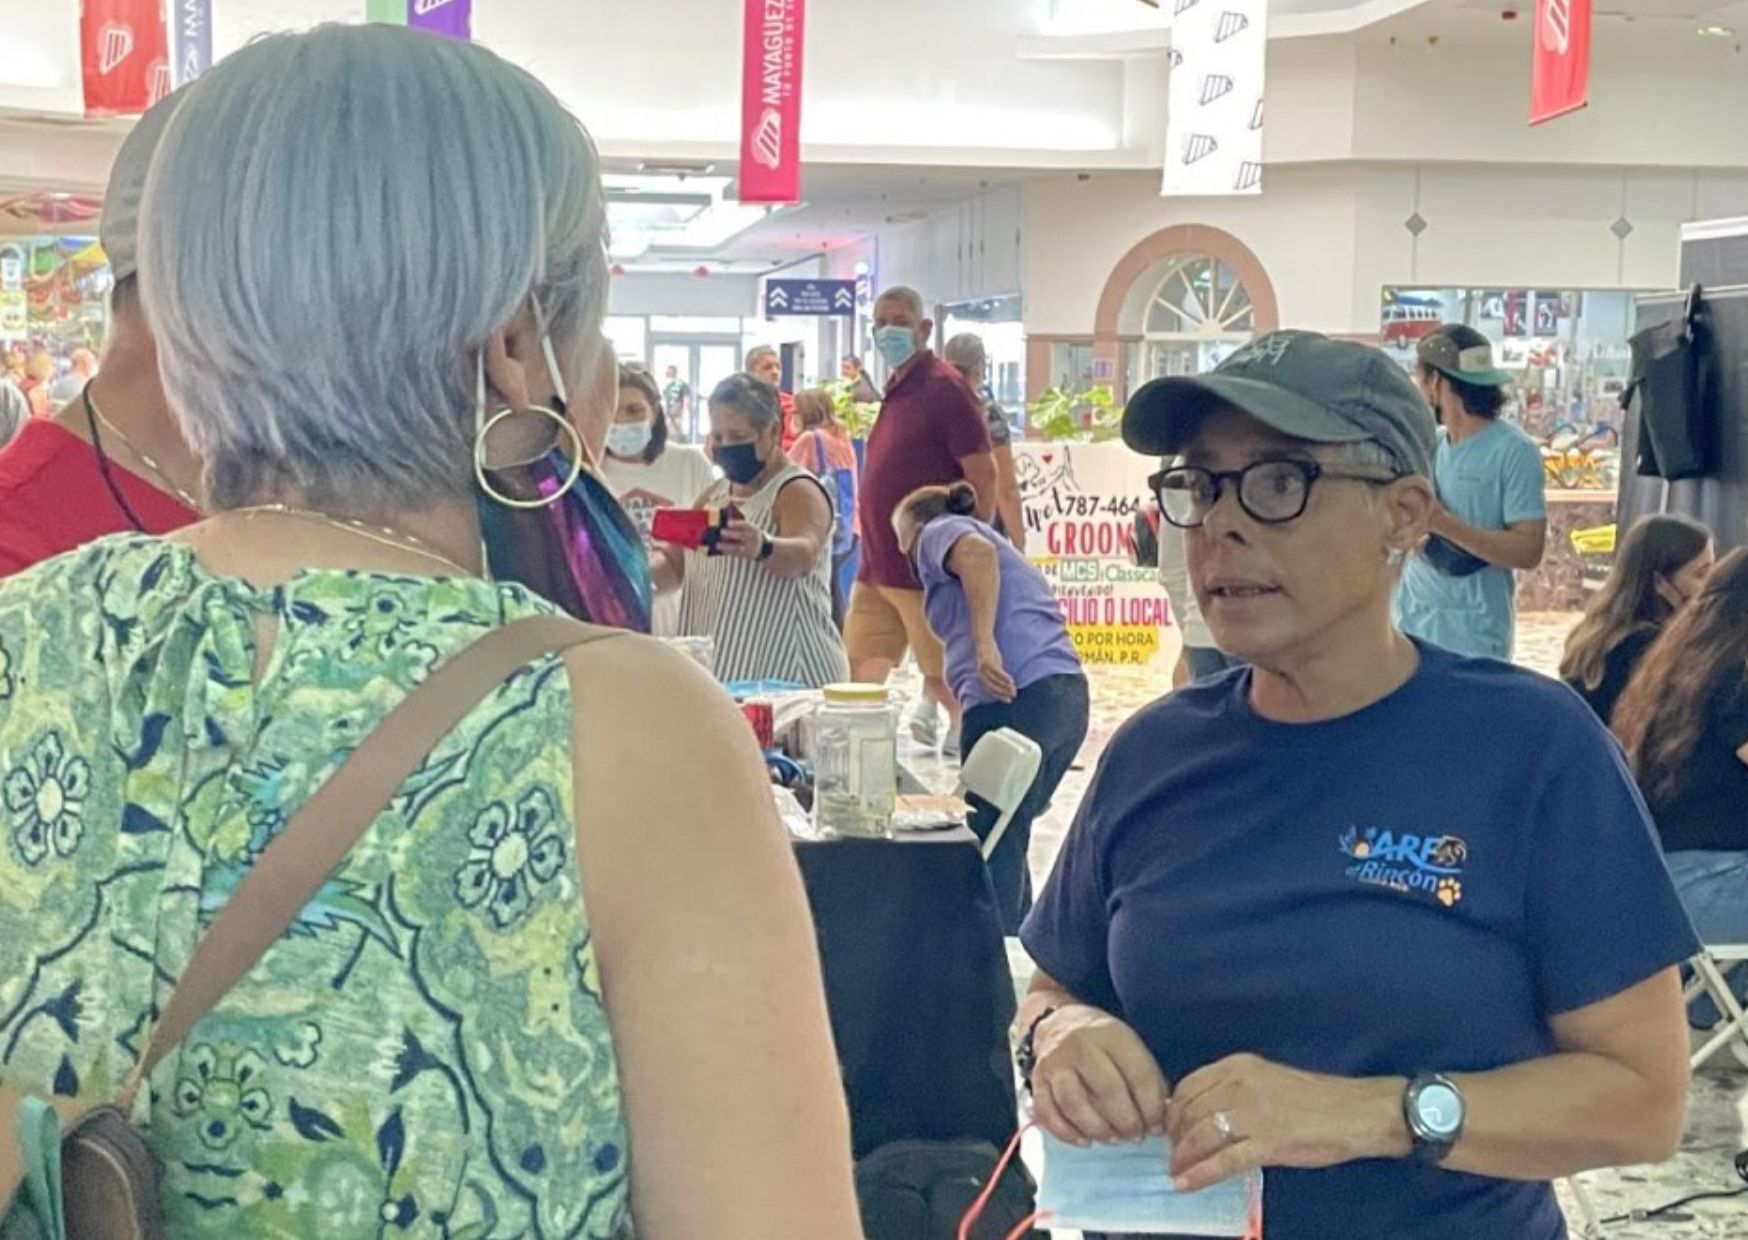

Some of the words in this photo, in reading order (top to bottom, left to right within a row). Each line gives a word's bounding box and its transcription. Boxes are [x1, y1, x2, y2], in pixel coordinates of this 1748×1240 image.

[1062, 559, 1099, 582] MCS
[1105, 598, 1115, 626] O
[1121, 598, 1172, 627] LOCAL
[1087, 632, 1113, 645] POR
[1116, 632, 1153, 645] HORA
